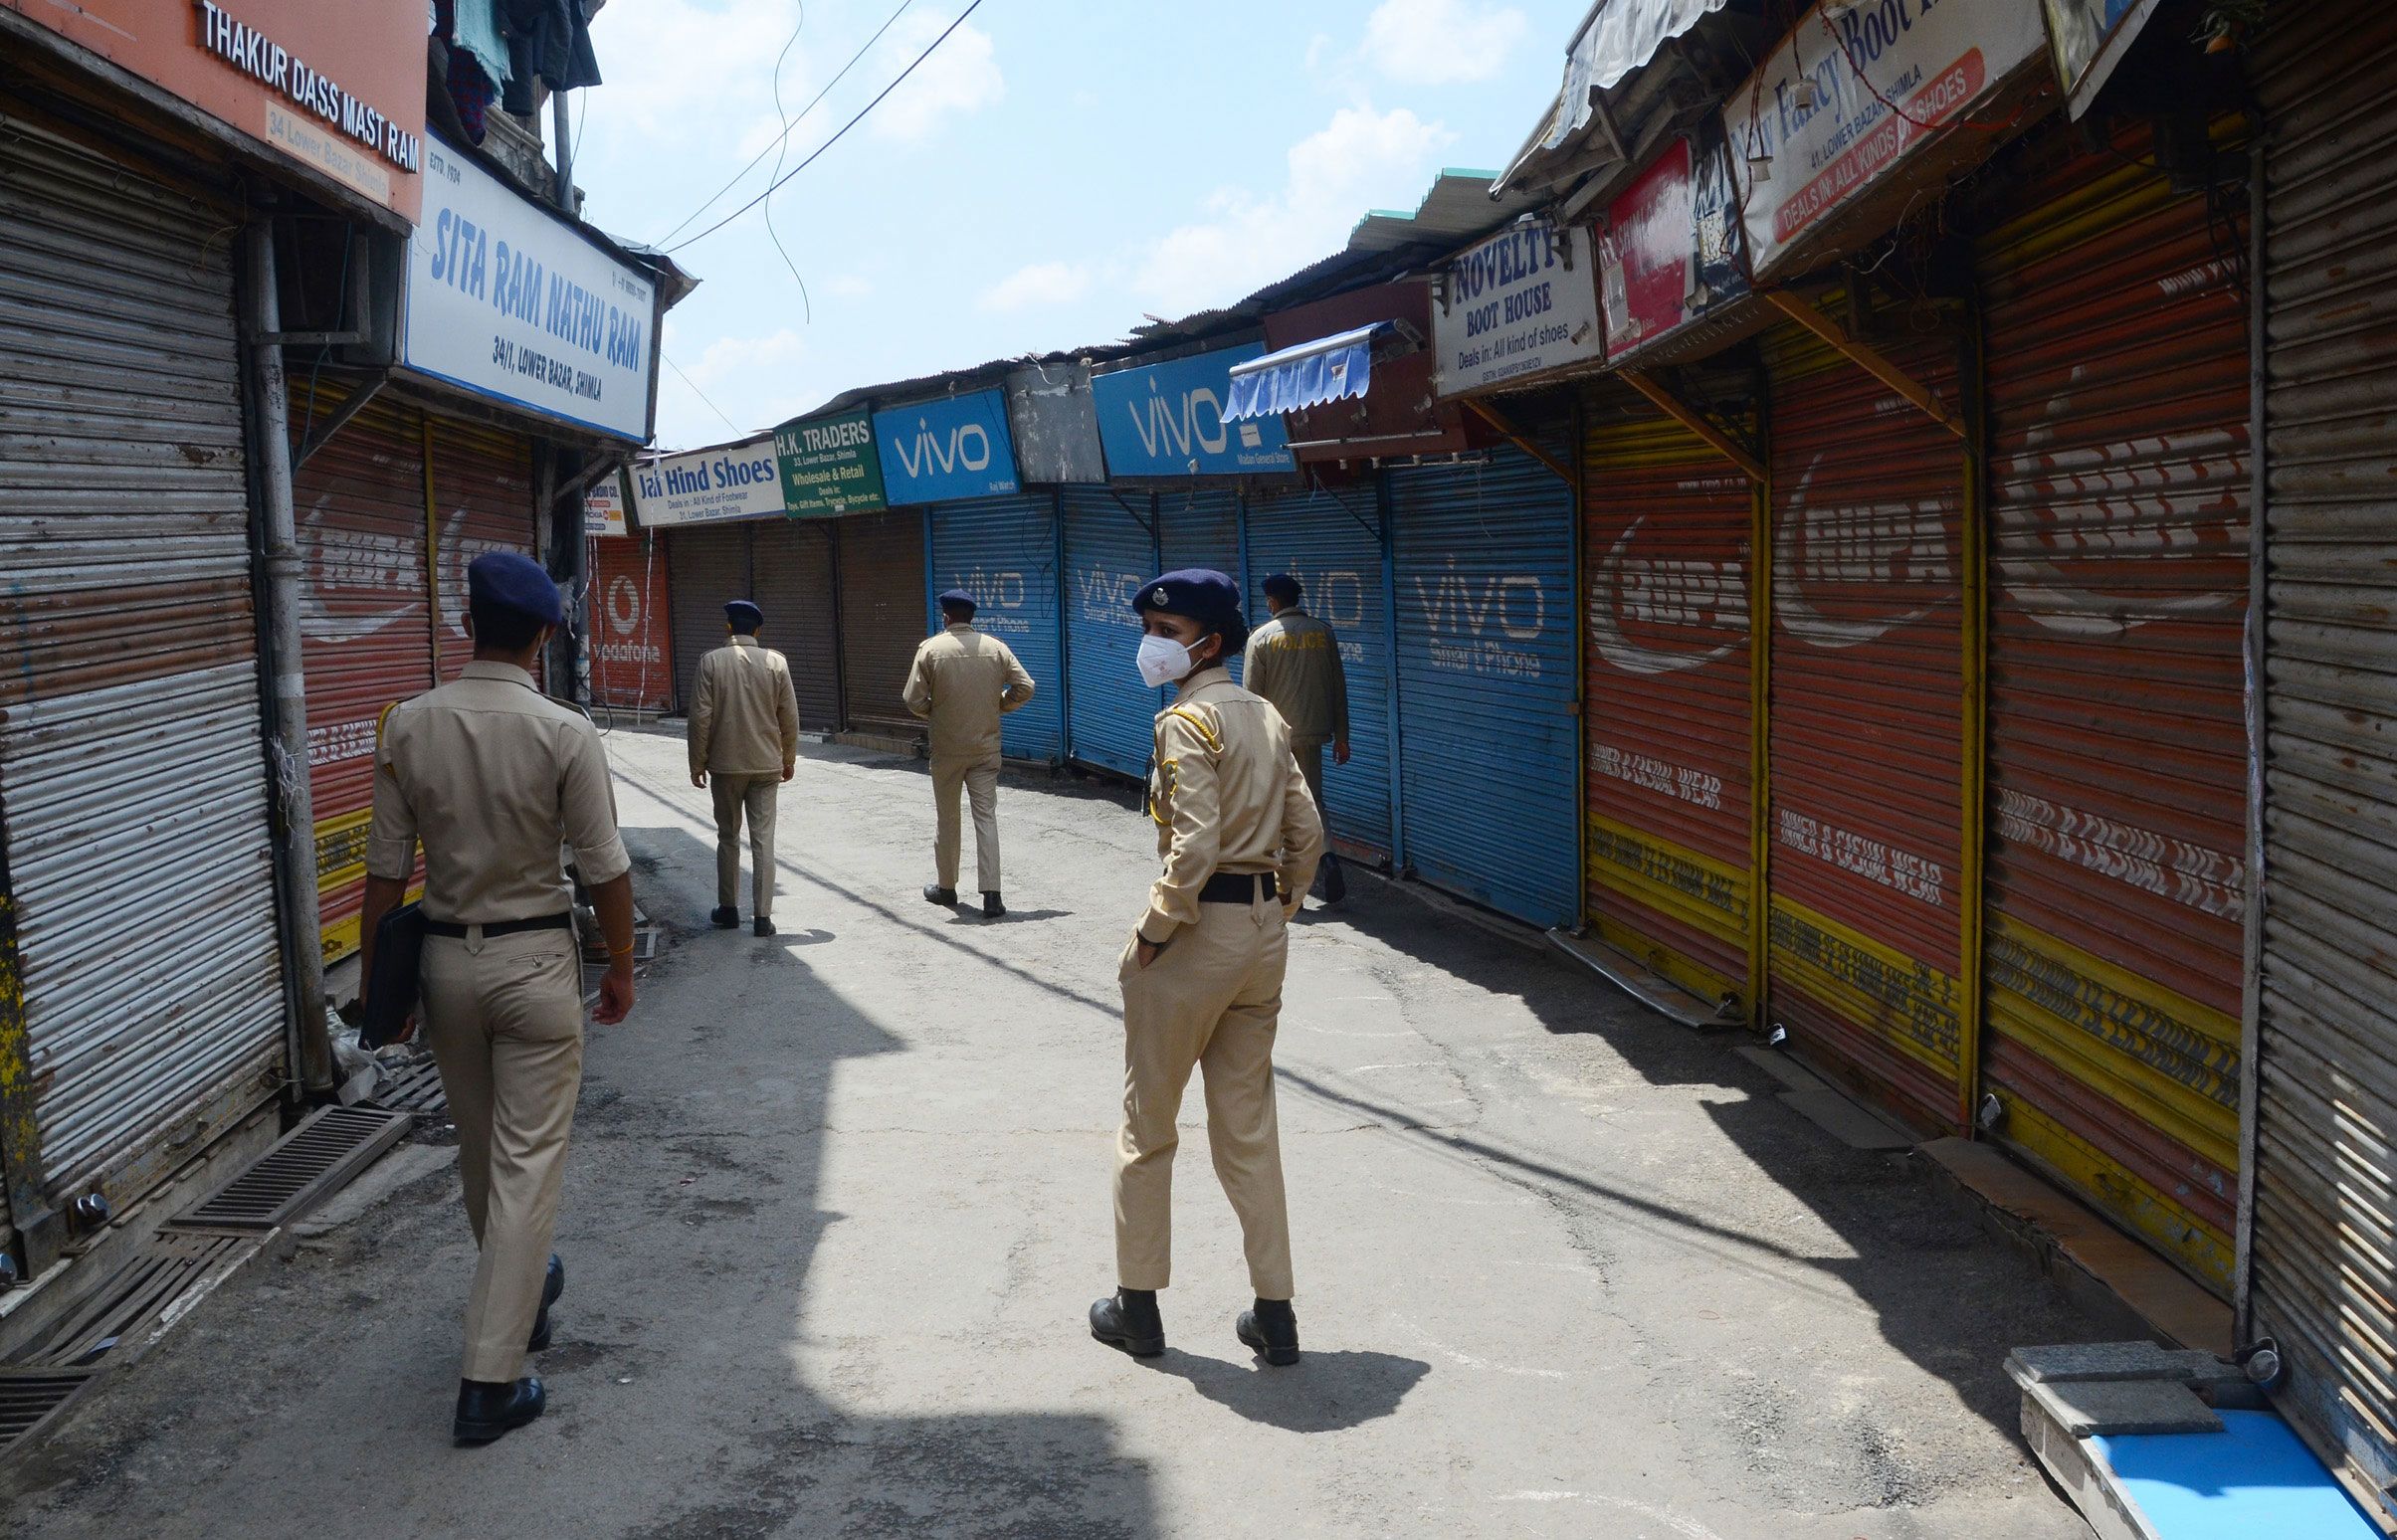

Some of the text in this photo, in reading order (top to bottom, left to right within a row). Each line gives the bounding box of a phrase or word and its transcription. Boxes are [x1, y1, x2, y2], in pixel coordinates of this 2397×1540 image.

[204, 0, 419, 173] THAKUR DASS MAST RAM
[1823, 122, 1855, 159] LOWER
[1885, 64, 1923, 102] SHIMLA
[270, 110, 387, 196] 34 Lower Bazar Shimla
[430, 151, 446, 177] ESTD.
[1782, 187, 1820, 232] DEALS
[1835, 161, 1860, 194] ALL
[1858, 132, 1896, 175] KINDS
[1914, 67, 1967, 124] SHOES
[431, 207, 642, 373] SITA RAM NATHU RAM
[1456, 224, 1555, 304] NOVELTY
[1467, 282, 1552, 337] BOOT HOUSE
[518, 346, 547, 384] LOWER
[548, 358, 574, 396] BAZAR,
[575, 370, 602, 402] SHIMLA
[1458, 322, 1569, 370] Deals in: All kind of shoes
[775, 420, 871, 457] H.K. TRADERS
[1128, 374, 1228, 459] vivo
[792, 464, 865, 485] Wholesale & Retail
[803, 457, 819, 467] Lower
[837, 450, 857, 461] Shimla
[895, 417, 990, 479] vivo
[1255, 453, 1275, 465] General
[1275, 453, 1291, 464] Store
[638, 456, 775, 499] Jai Hind Shoes
[668, 499, 684, 509] Deals
[700, 494, 715, 506] Kind
[715, 493, 721, 502] of
[721, 490, 748, 501] Footwear
[689, 510, 704, 519] Lower
[722, 504, 741, 515] Shimla
[1806, 500, 1952, 582] RUPA
[1414, 552, 1545, 639] vivo
[1621, 559, 1752, 633] RUPA
[1429, 638, 1543, 678] Smart Phone
[1891, 848, 1943, 906] WEAR
[2171, 839, 2246, 924] WEA
